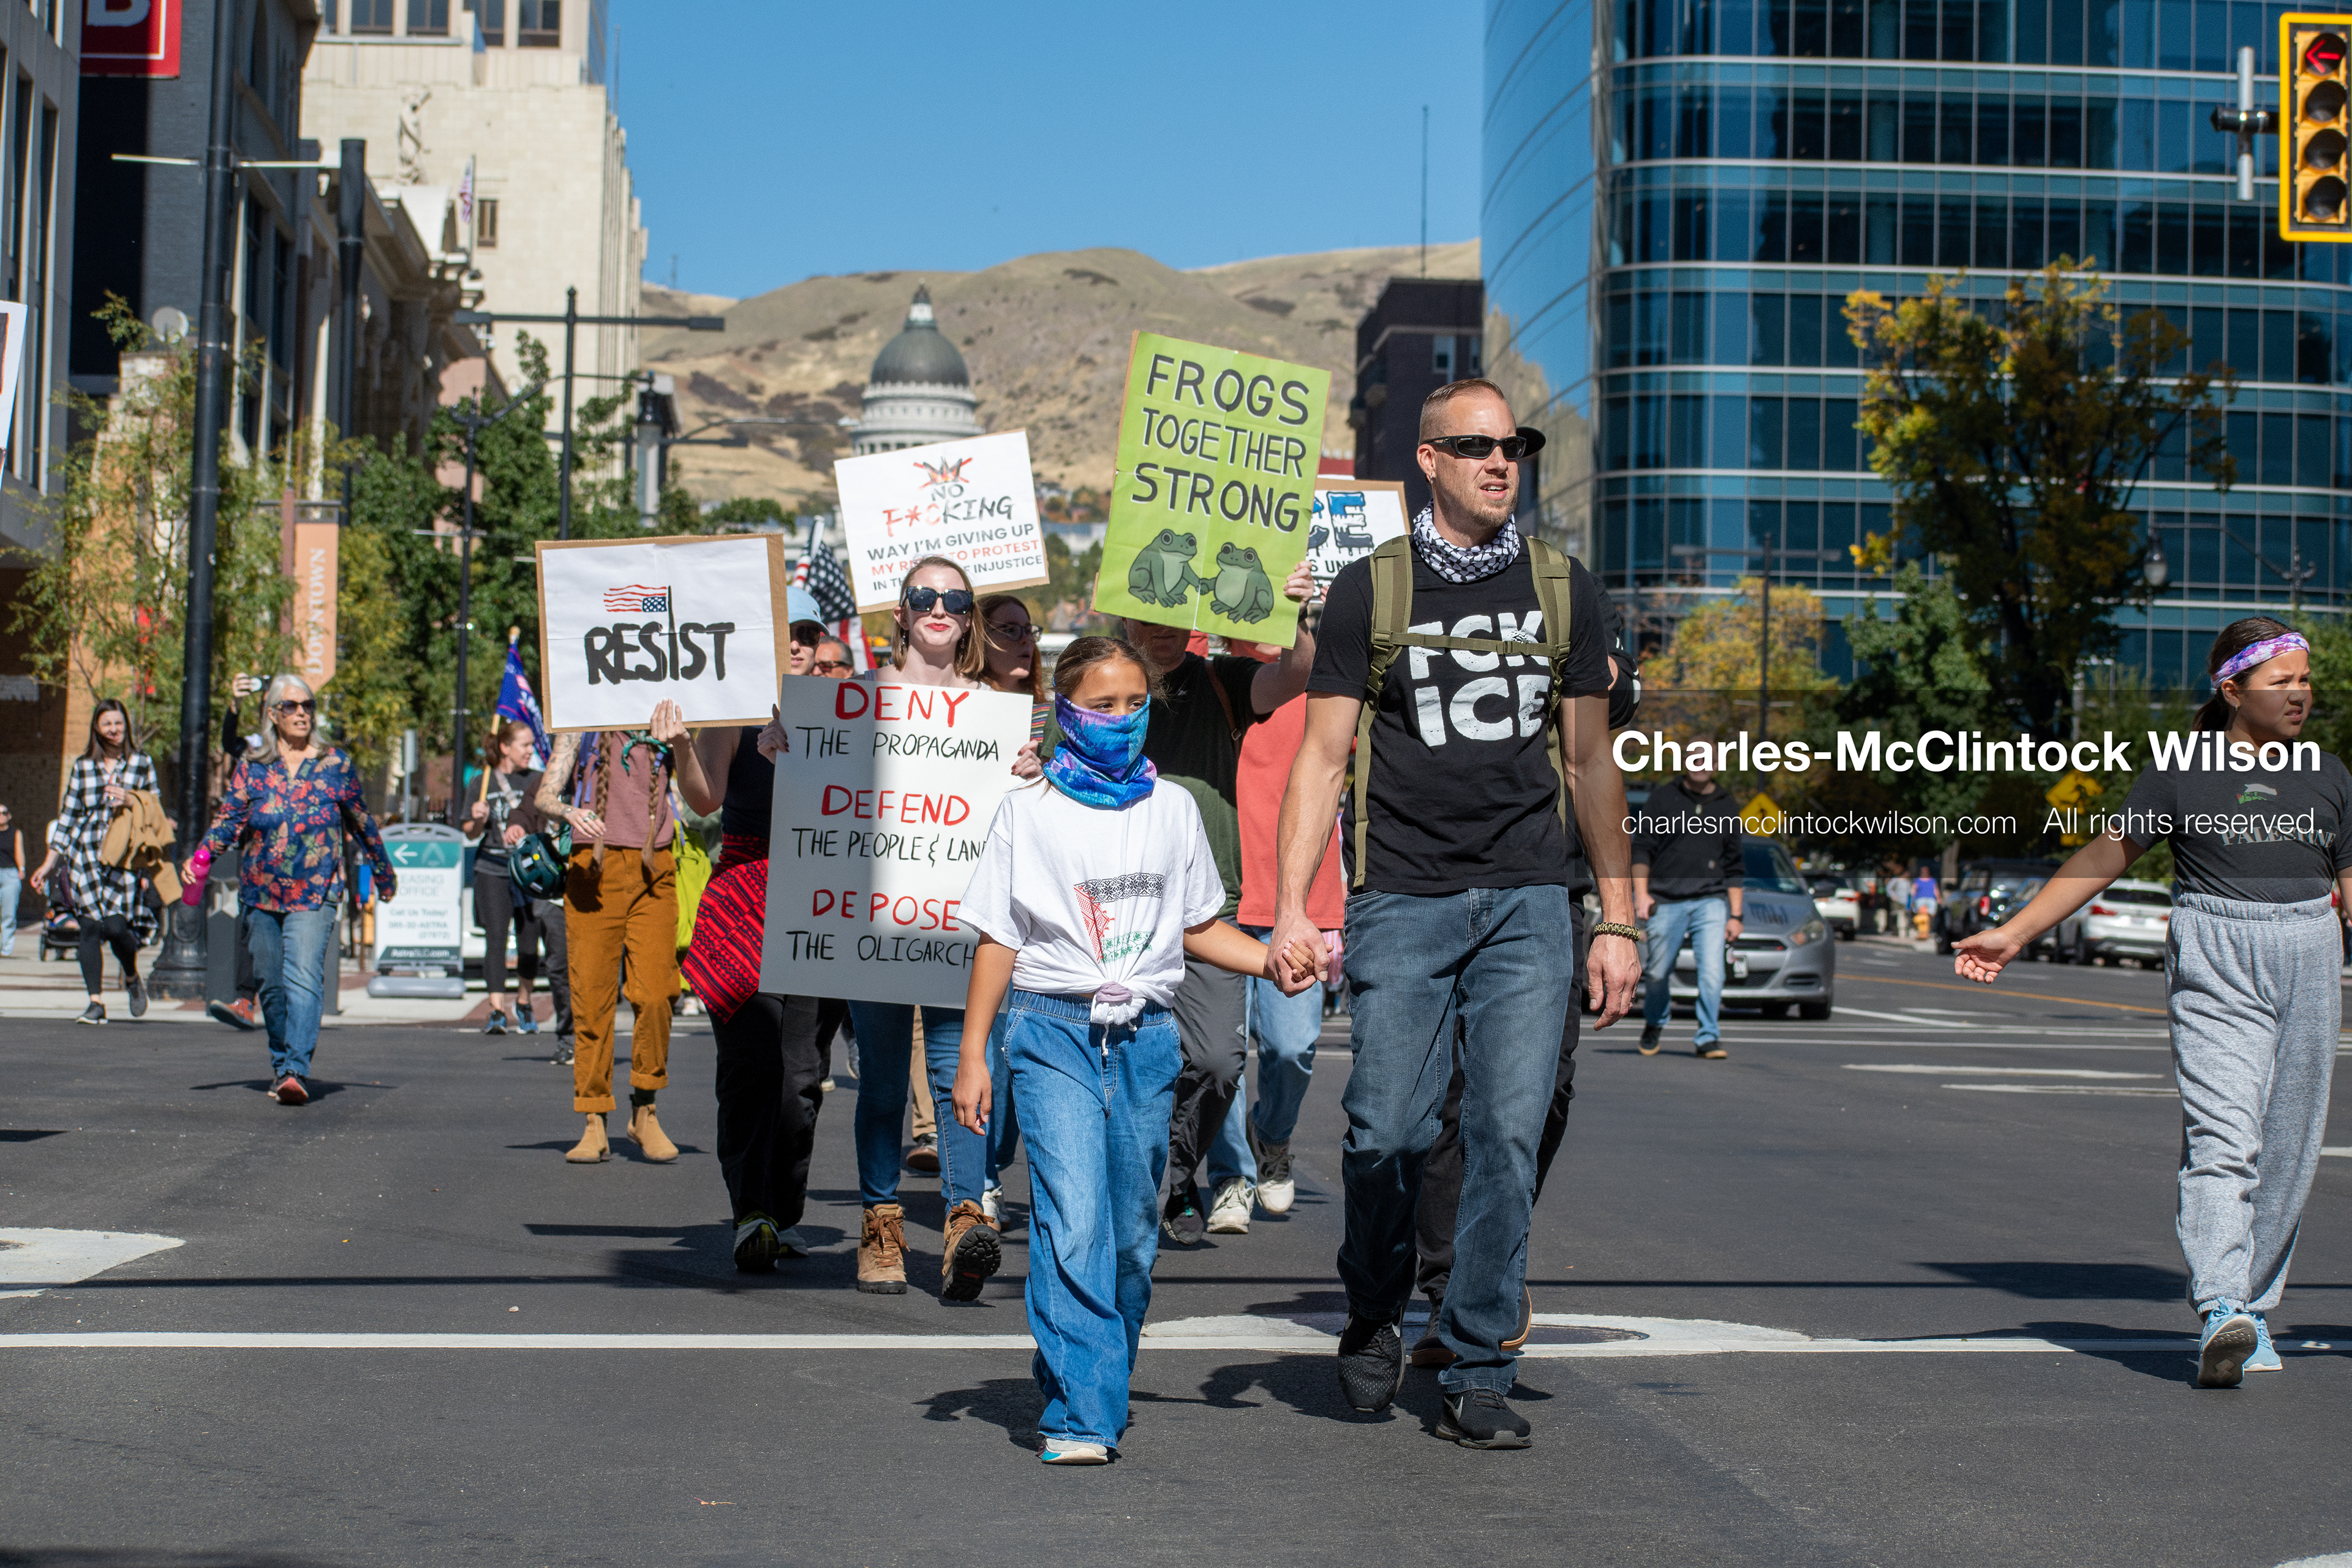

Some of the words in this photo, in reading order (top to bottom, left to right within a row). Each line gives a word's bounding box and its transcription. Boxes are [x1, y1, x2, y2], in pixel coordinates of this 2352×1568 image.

[1145, 353, 1310, 426] FROGS
[1142, 407, 1306, 480] TOGETHER
[931, 483, 964, 501] NO
[1131, 462, 1300, 533] STRONG
[867, 543, 910, 561] WAY
[914, 538, 941, 553] I'M
[945, 528, 1007, 546] GIVING
[1011, 524, 1035, 537] UP
[872, 562, 895, 576] MY
[949, 551, 968, 562] TO
[973, 540, 1039, 559] PROTEST
[873, 580, 887, 590] IN
[974, 554, 1043, 573] INJUSTICE
[306, 548, 326, 674] DOWNTOWN
[584, 586, 735, 685] RESIST
[1407, 611, 1550, 679] FCK
[835, 682, 970, 728] DENY
[1414, 674, 1550, 747] ICE
[796, 726, 851, 759] THE
[872, 732, 999, 762] PROPAGANDA
[821, 785, 970, 826] DEFEND
[791, 827, 839, 858] THE
[848, 831, 925, 861] PEOPLE
[2219, 826, 2336, 848] PALESTINE
[399, 886, 437, 896] OFFICE
[400, 874, 443, 884] EASING
[813, 889, 962, 932] DEPOSE
[786, 930, 835, 961] THE
